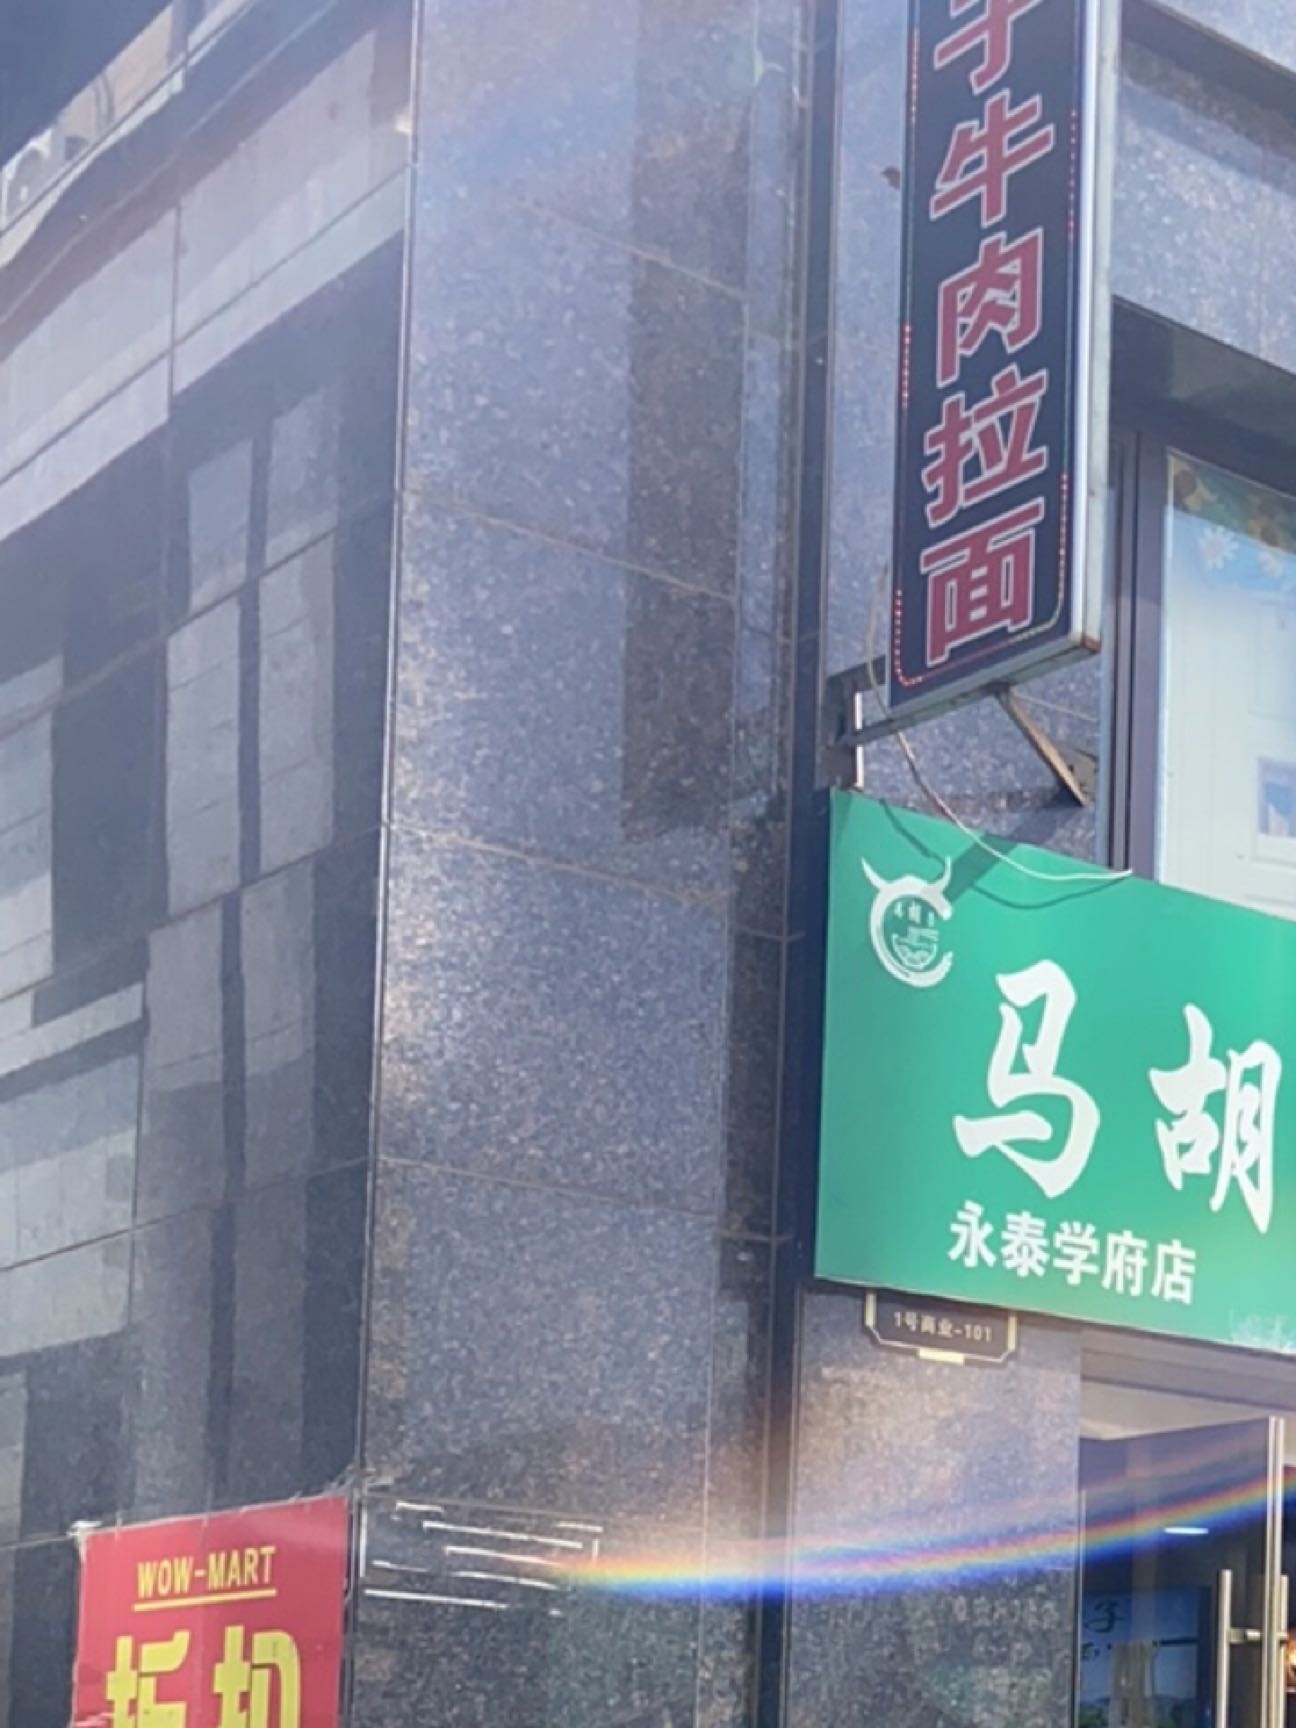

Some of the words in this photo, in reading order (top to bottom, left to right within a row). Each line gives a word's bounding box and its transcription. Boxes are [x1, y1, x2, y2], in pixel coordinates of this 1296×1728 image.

[948, 1200, 1196, 1305] 永泰学府店
[137, 1545, 277, 1598] WOW-MART
